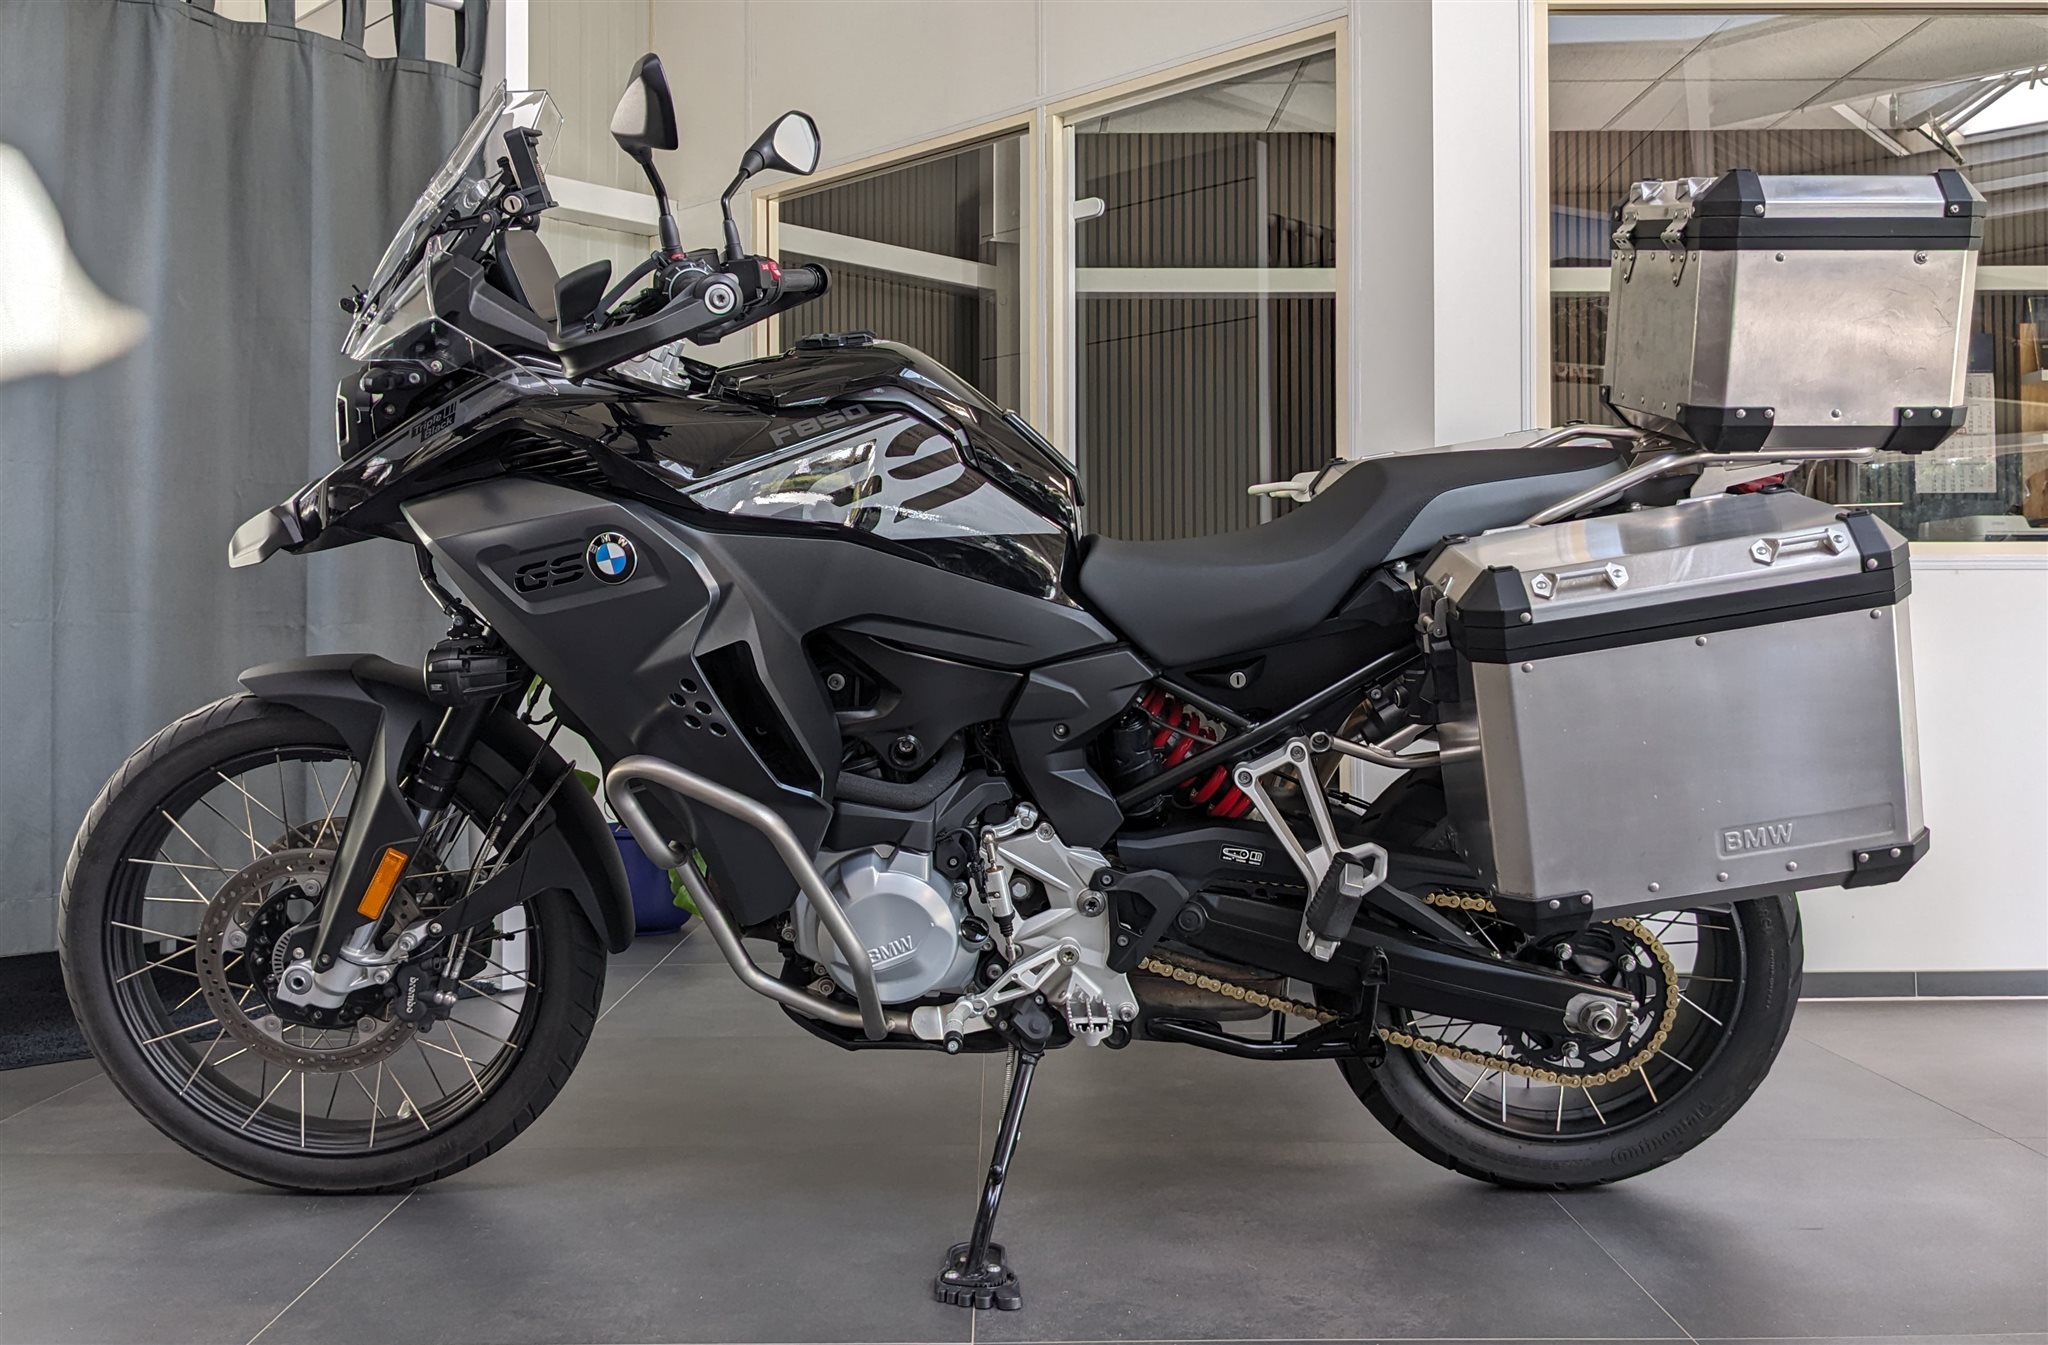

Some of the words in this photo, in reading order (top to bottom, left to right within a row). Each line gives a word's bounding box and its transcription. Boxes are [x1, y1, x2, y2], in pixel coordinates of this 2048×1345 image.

[414, 413, 442, 435] Triple
[424, 416, 453, 439] Black
[769, 404, 871, 447] F850
[589, 533, 628, 554] BMW
[514, 552, 585, 593] GS
[1723, 822, 1793, 852] BMW
[867, 935, 913, 963] BMW
[406, 976, 419, 1014] brembo
[1608, 1106, 1704, 1167] Continental
